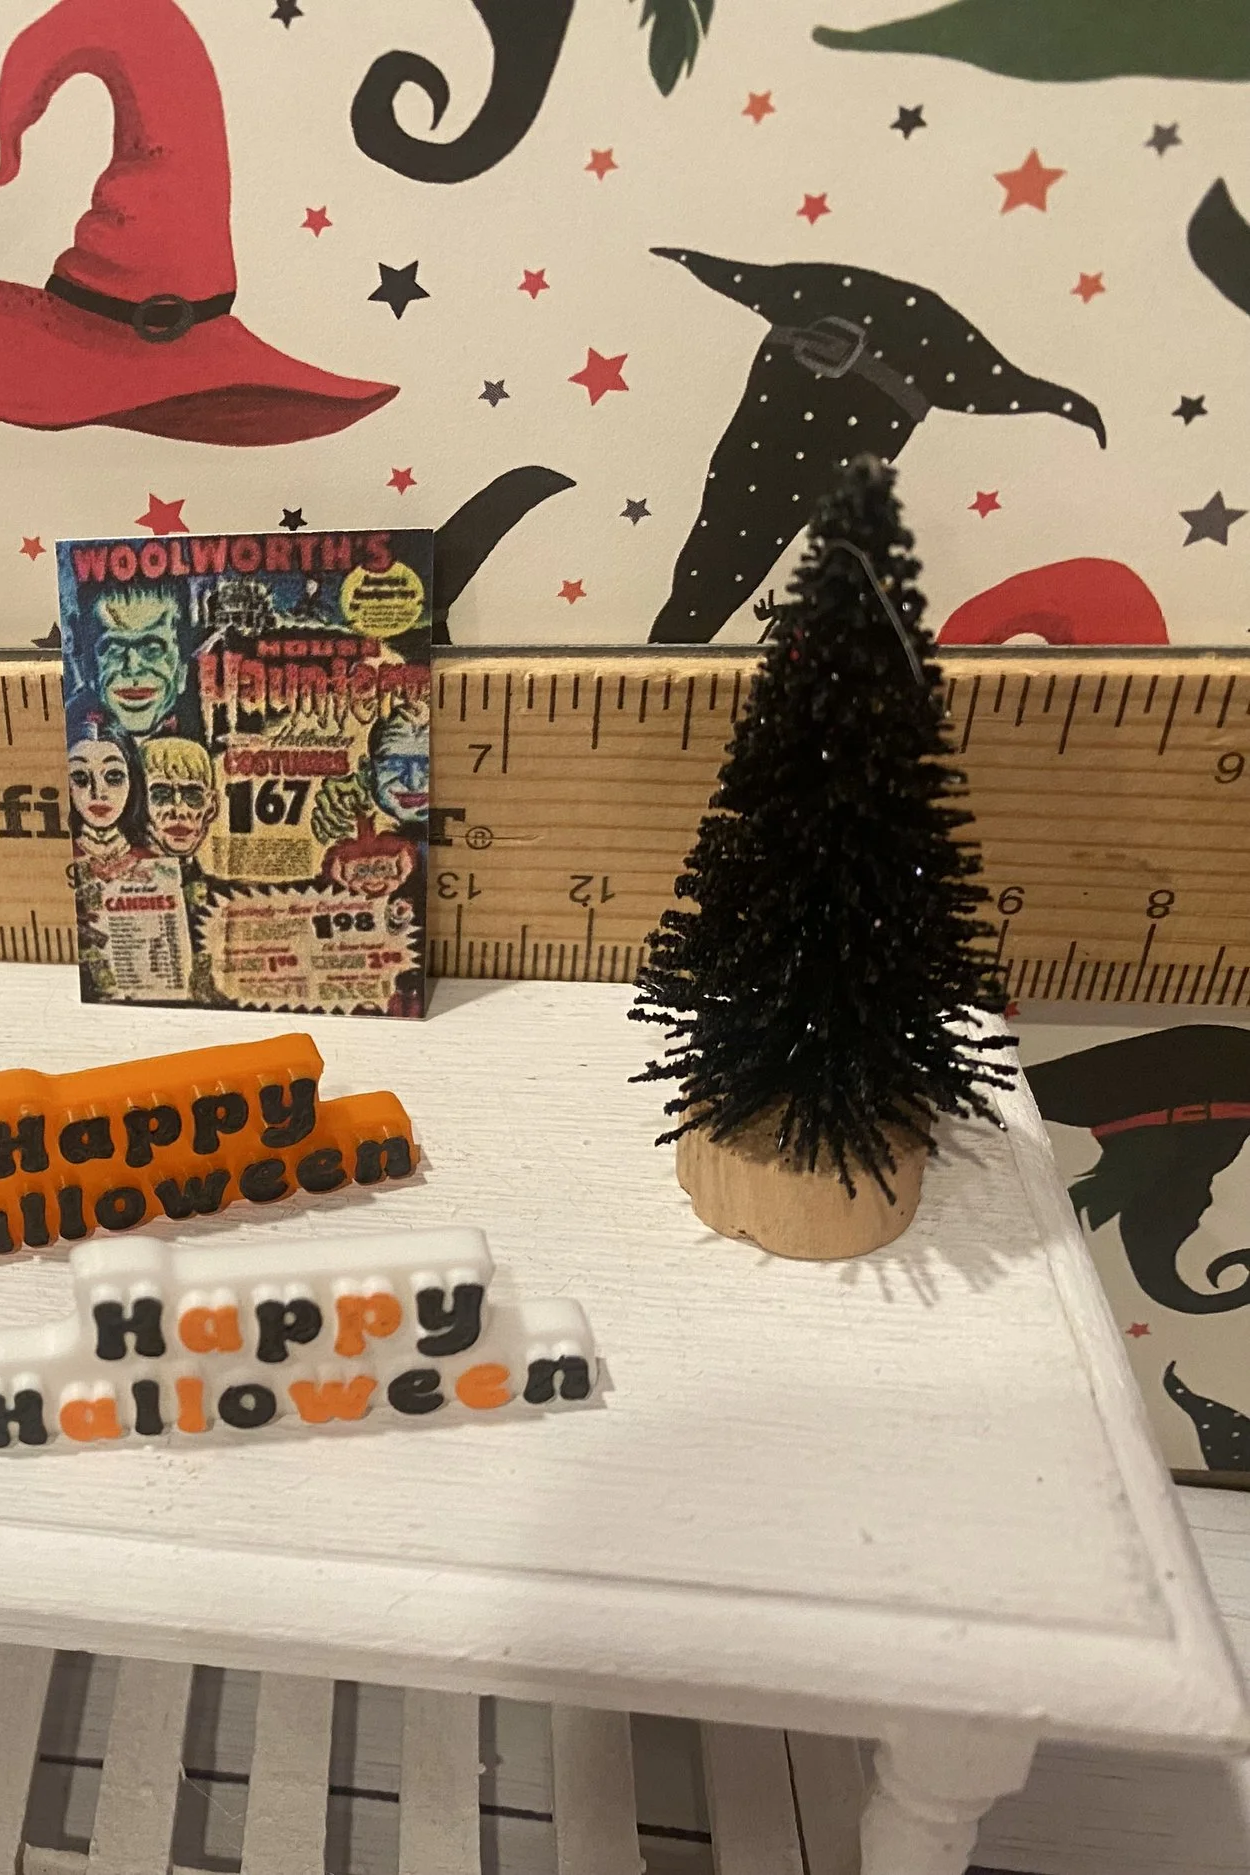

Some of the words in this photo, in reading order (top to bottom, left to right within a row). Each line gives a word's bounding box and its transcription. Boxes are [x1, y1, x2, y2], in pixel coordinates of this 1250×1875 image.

[72, 533, 393, 581] WOOLWORTH'S
[468, 744, 492, 773] 7
[1214, 751, 1245, 784] 9
[105, 895, 176, 912] CANDIES
[436, 872, 482, 900] 13
[568, 875, 616, 904] 12
[1146, 889, 1175, 919] 8
[312, 912, 376, 939] 198
[93, 1283, 485, 1361] Happy
